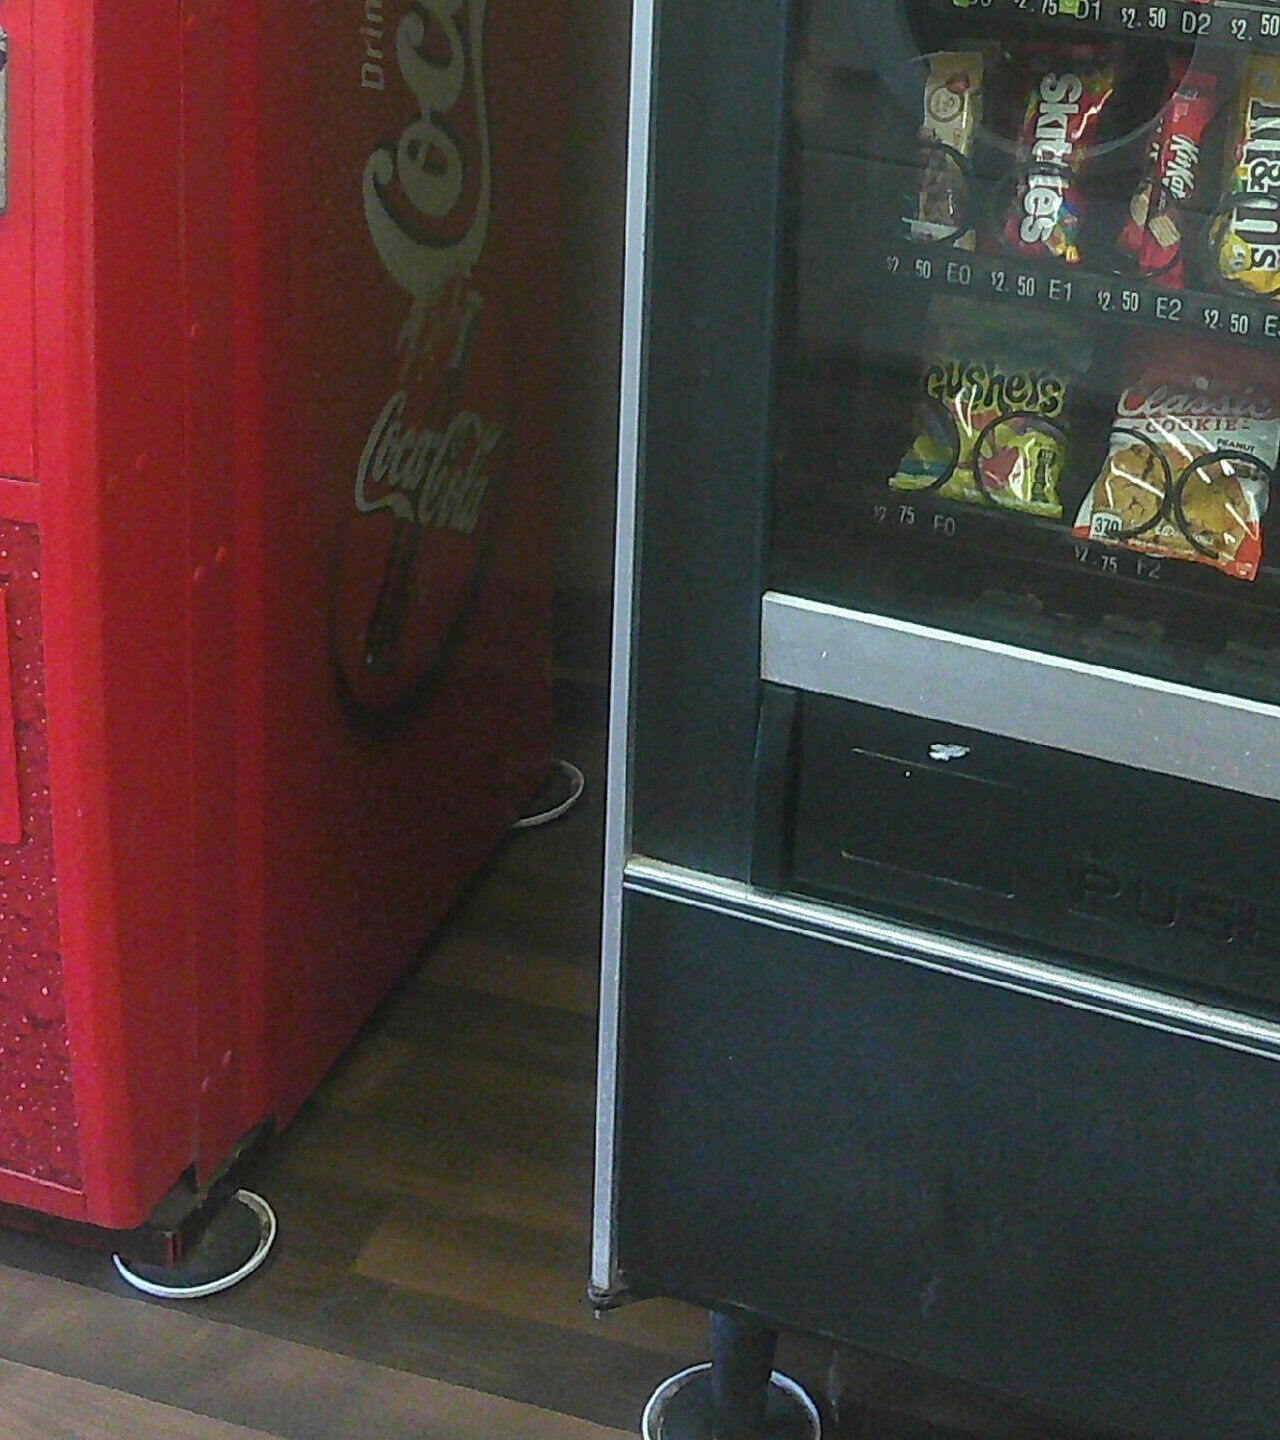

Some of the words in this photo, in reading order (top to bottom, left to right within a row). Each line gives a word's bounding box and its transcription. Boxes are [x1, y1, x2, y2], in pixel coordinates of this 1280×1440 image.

[1181, 11, 1212, 35] D2
[1048, 278, 1072, 303] E1
[1155, 296, 1183, 322] E2
[924, 360, 1066, 418] Gushers
[1116, 385, 1273, 418] Classic
